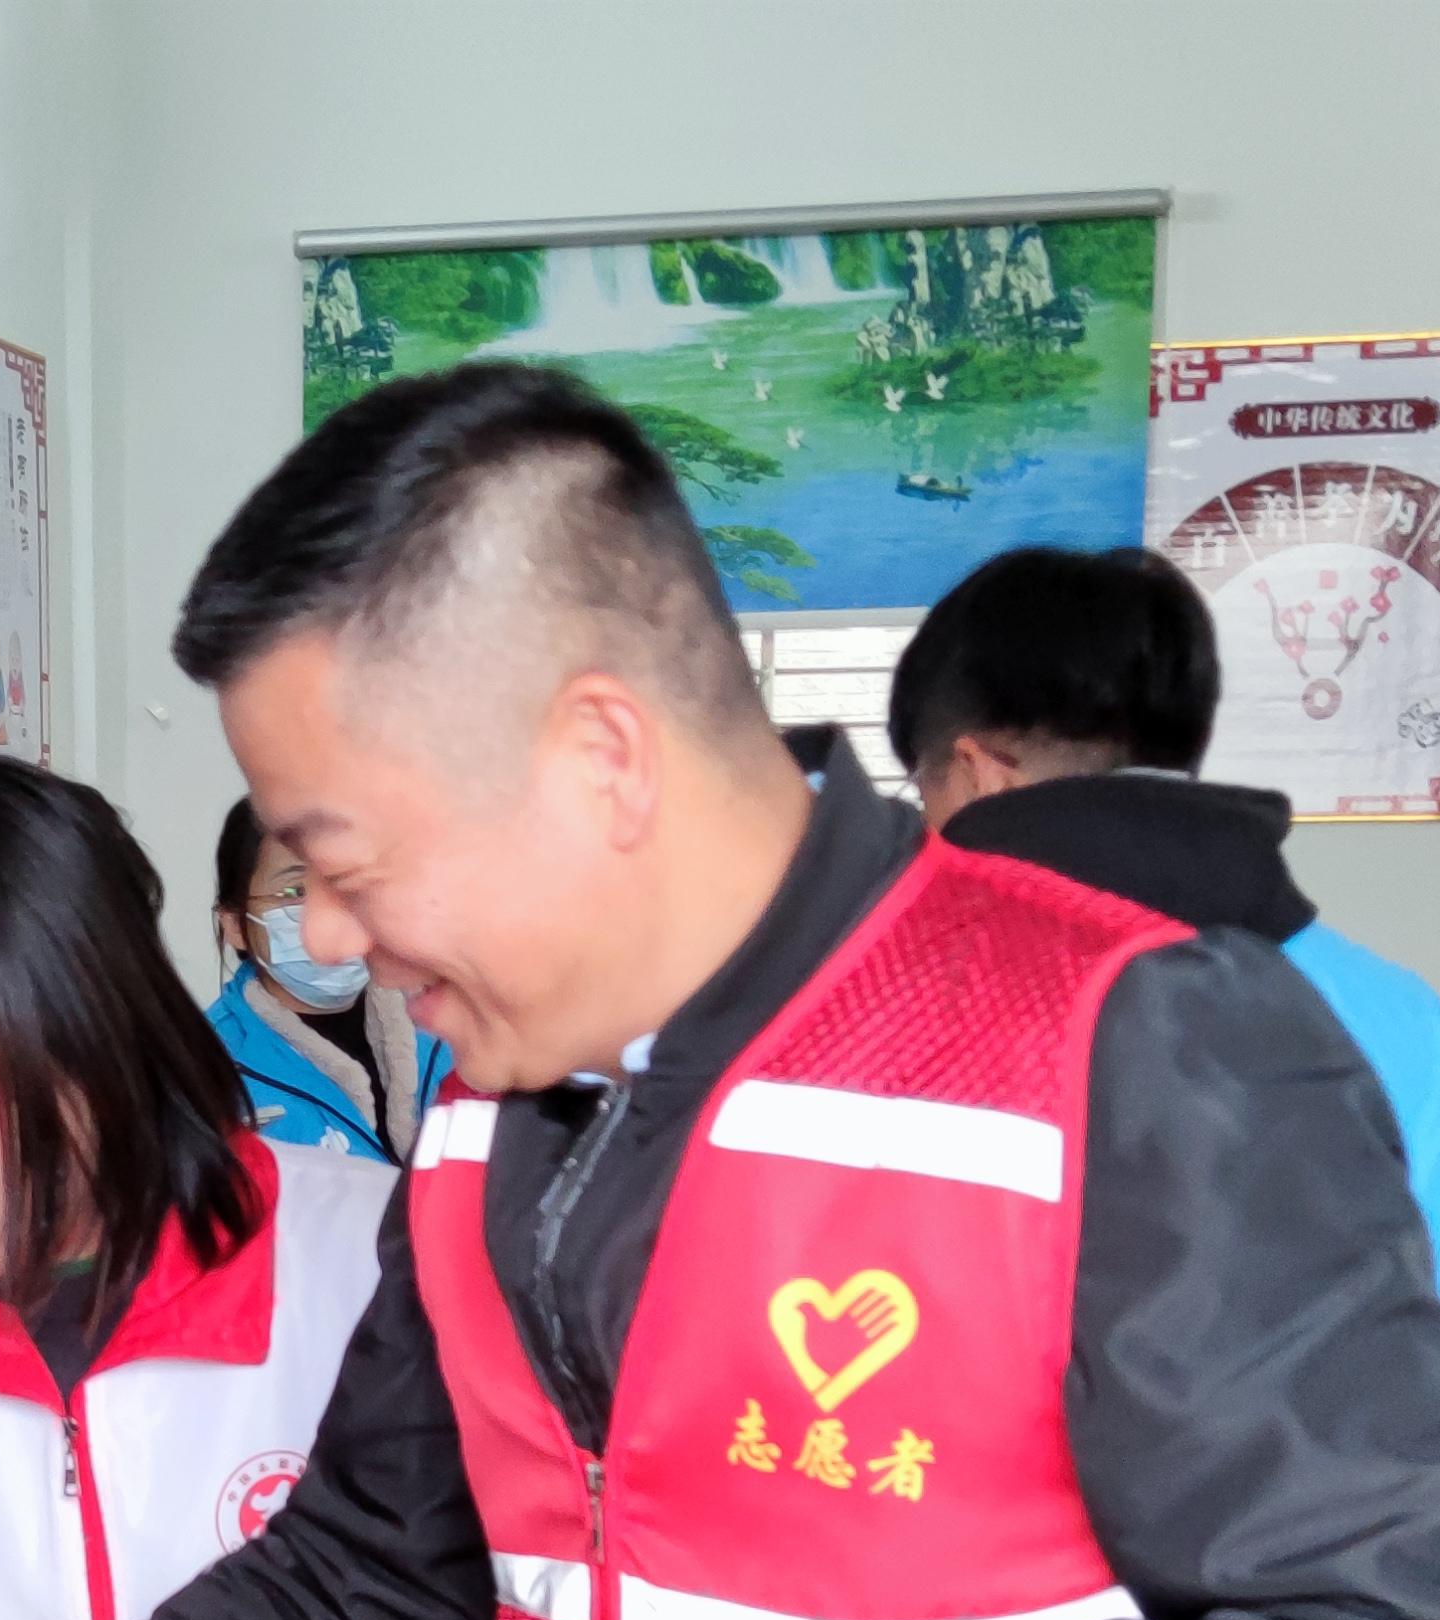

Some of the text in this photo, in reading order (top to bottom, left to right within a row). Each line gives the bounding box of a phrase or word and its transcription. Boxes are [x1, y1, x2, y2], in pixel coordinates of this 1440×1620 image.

[1257, 401, 1415, 433] 中华传统文化
[727, 1398, 936, 1502] 志愿者
